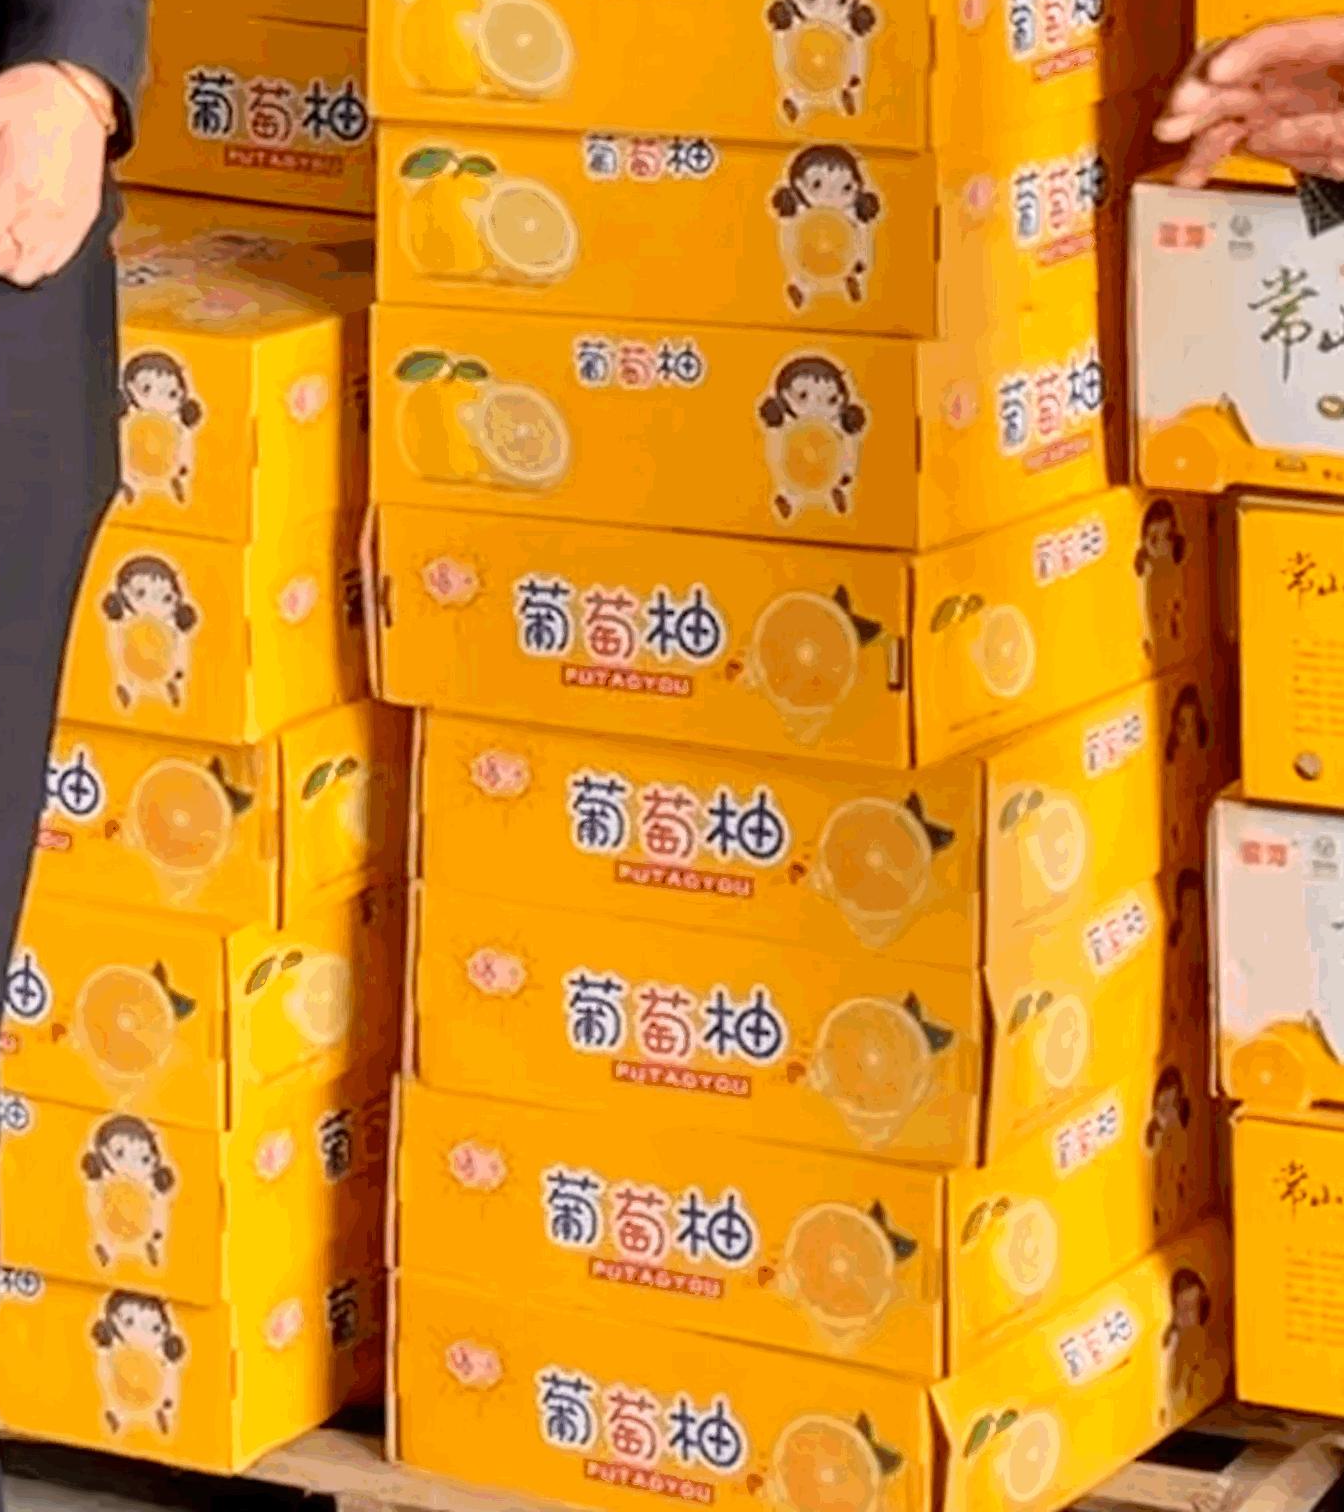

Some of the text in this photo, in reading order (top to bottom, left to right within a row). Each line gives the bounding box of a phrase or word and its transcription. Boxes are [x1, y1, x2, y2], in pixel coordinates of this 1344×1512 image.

[189, 71, 369, 143] 葡萄柚
[577, 339, 703, 385] 葡萄柚
[518, 578, 722, 661] 葡萄柚
[571, 774, 786, 861] 葡萄柚
[568, 971, 783, 1061] 葡萄柚
[546, 1169, 753, 1264] 葡萄柚
[540, 1370, 742, 1468] 葡萄柚
